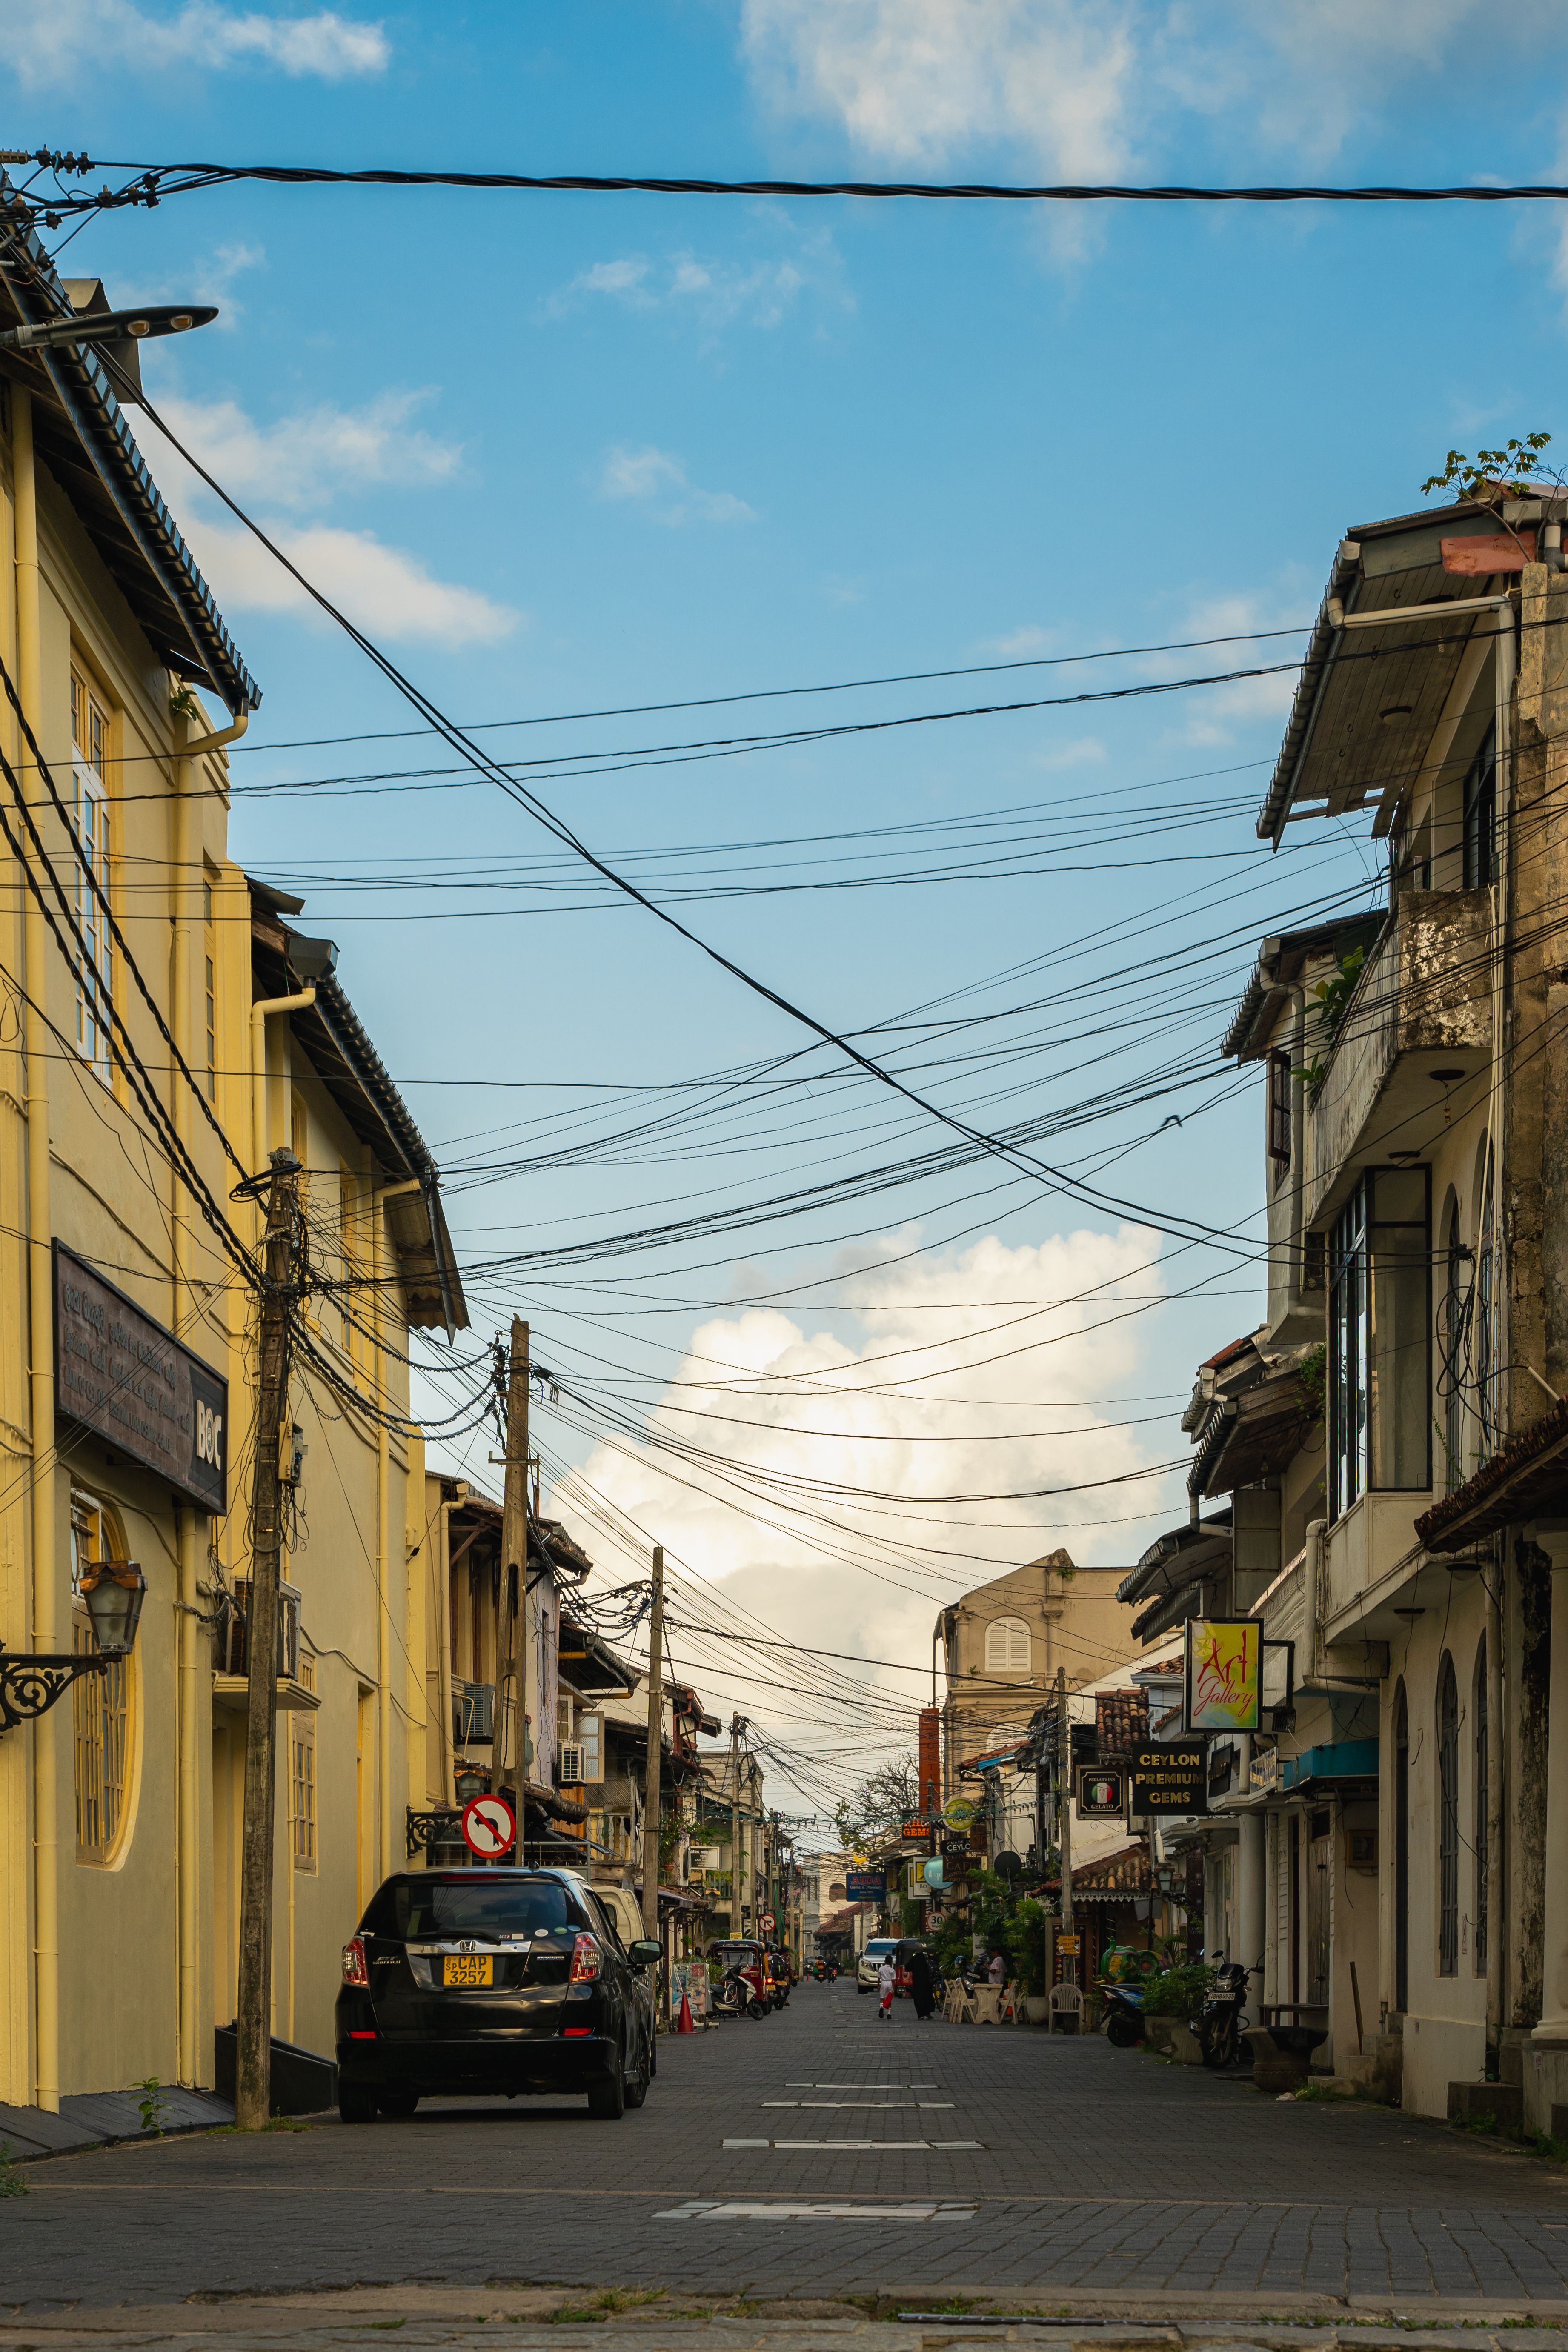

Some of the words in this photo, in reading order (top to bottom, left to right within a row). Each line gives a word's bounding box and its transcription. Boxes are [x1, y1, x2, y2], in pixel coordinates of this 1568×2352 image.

[197, 1399, 222, 1471] BOC
[1198, 1629, 1251, 1684] Art
[1194, 1676, 1255, 1717] Gallery
[1140, 1754, 1199, 1766] CEYLON
[1136, 1773, 1204, 1784] PREMIUM
[1149, 1791, 1191, 1803] GEMS
[851, 1876, 882, 1885] AIDA
[459, 1956, 487, 1969] CAP
[449, 1971, 486, 1984] 3257
